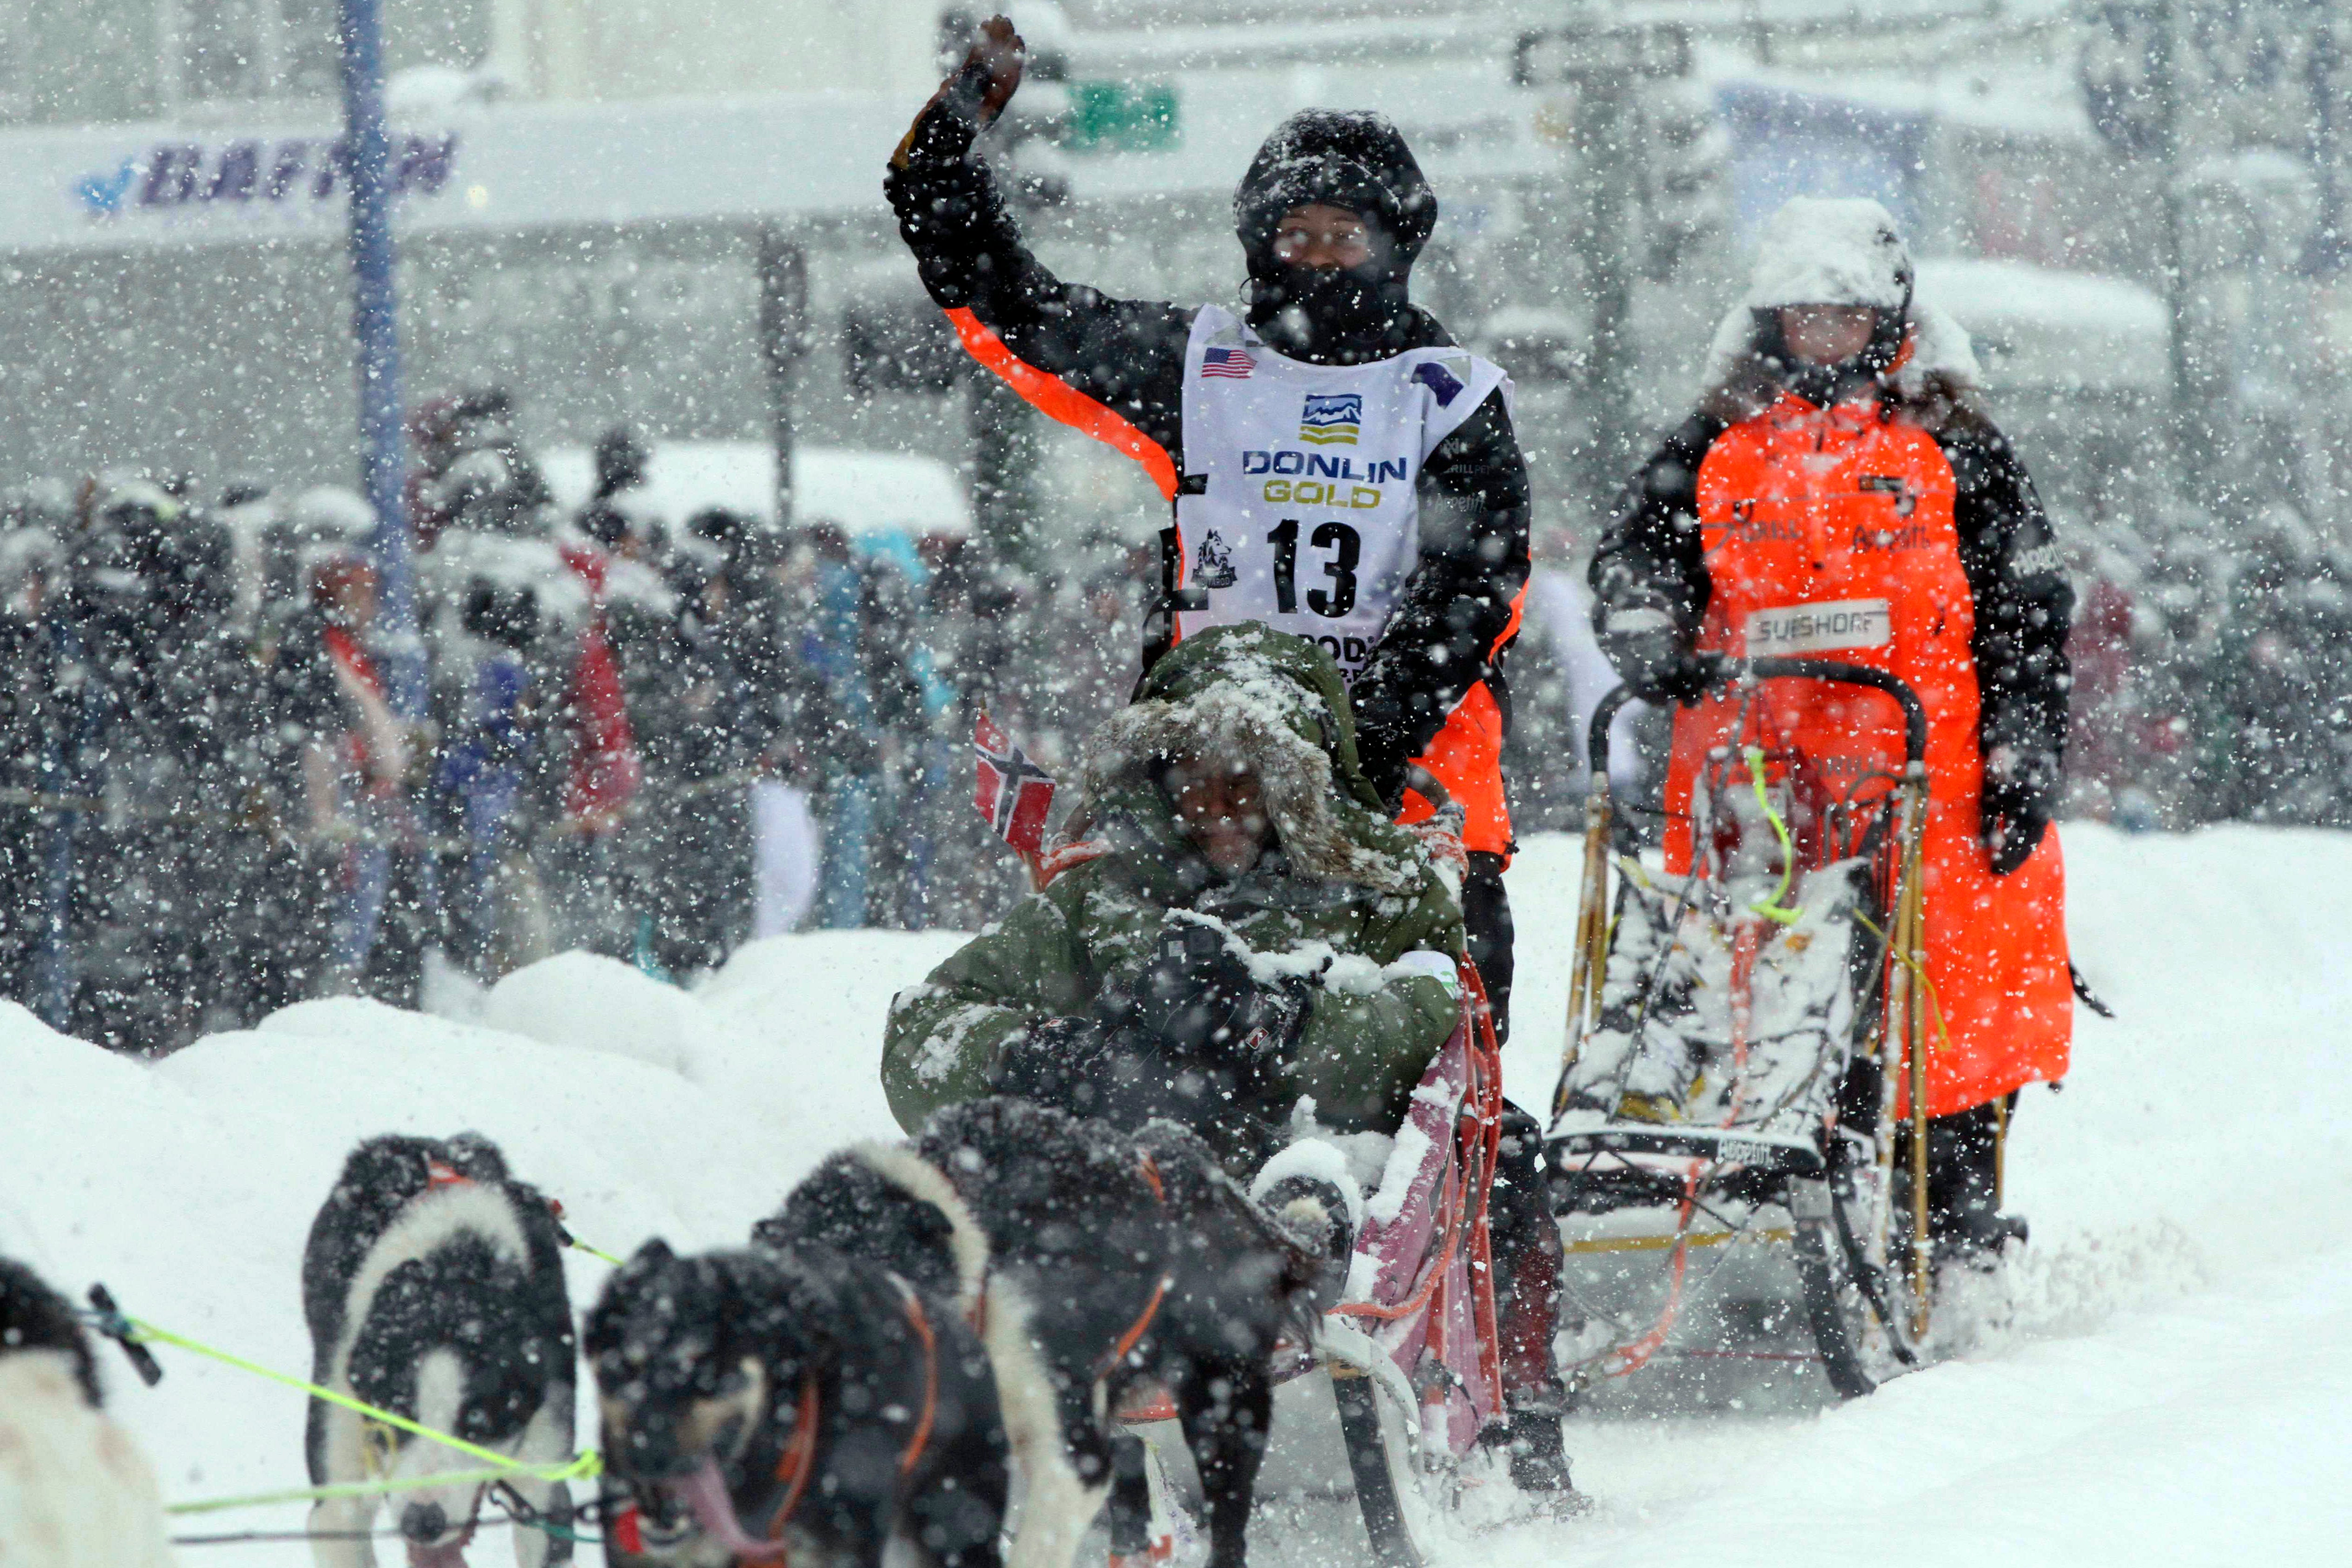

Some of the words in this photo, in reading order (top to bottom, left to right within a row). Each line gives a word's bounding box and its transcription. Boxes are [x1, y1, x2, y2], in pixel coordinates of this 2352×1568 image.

[1243, 451, 1406, 484] DONLIN
[1263, 479, 1381, 508] GOLD
[1267, 518, 1361, 618] 13
